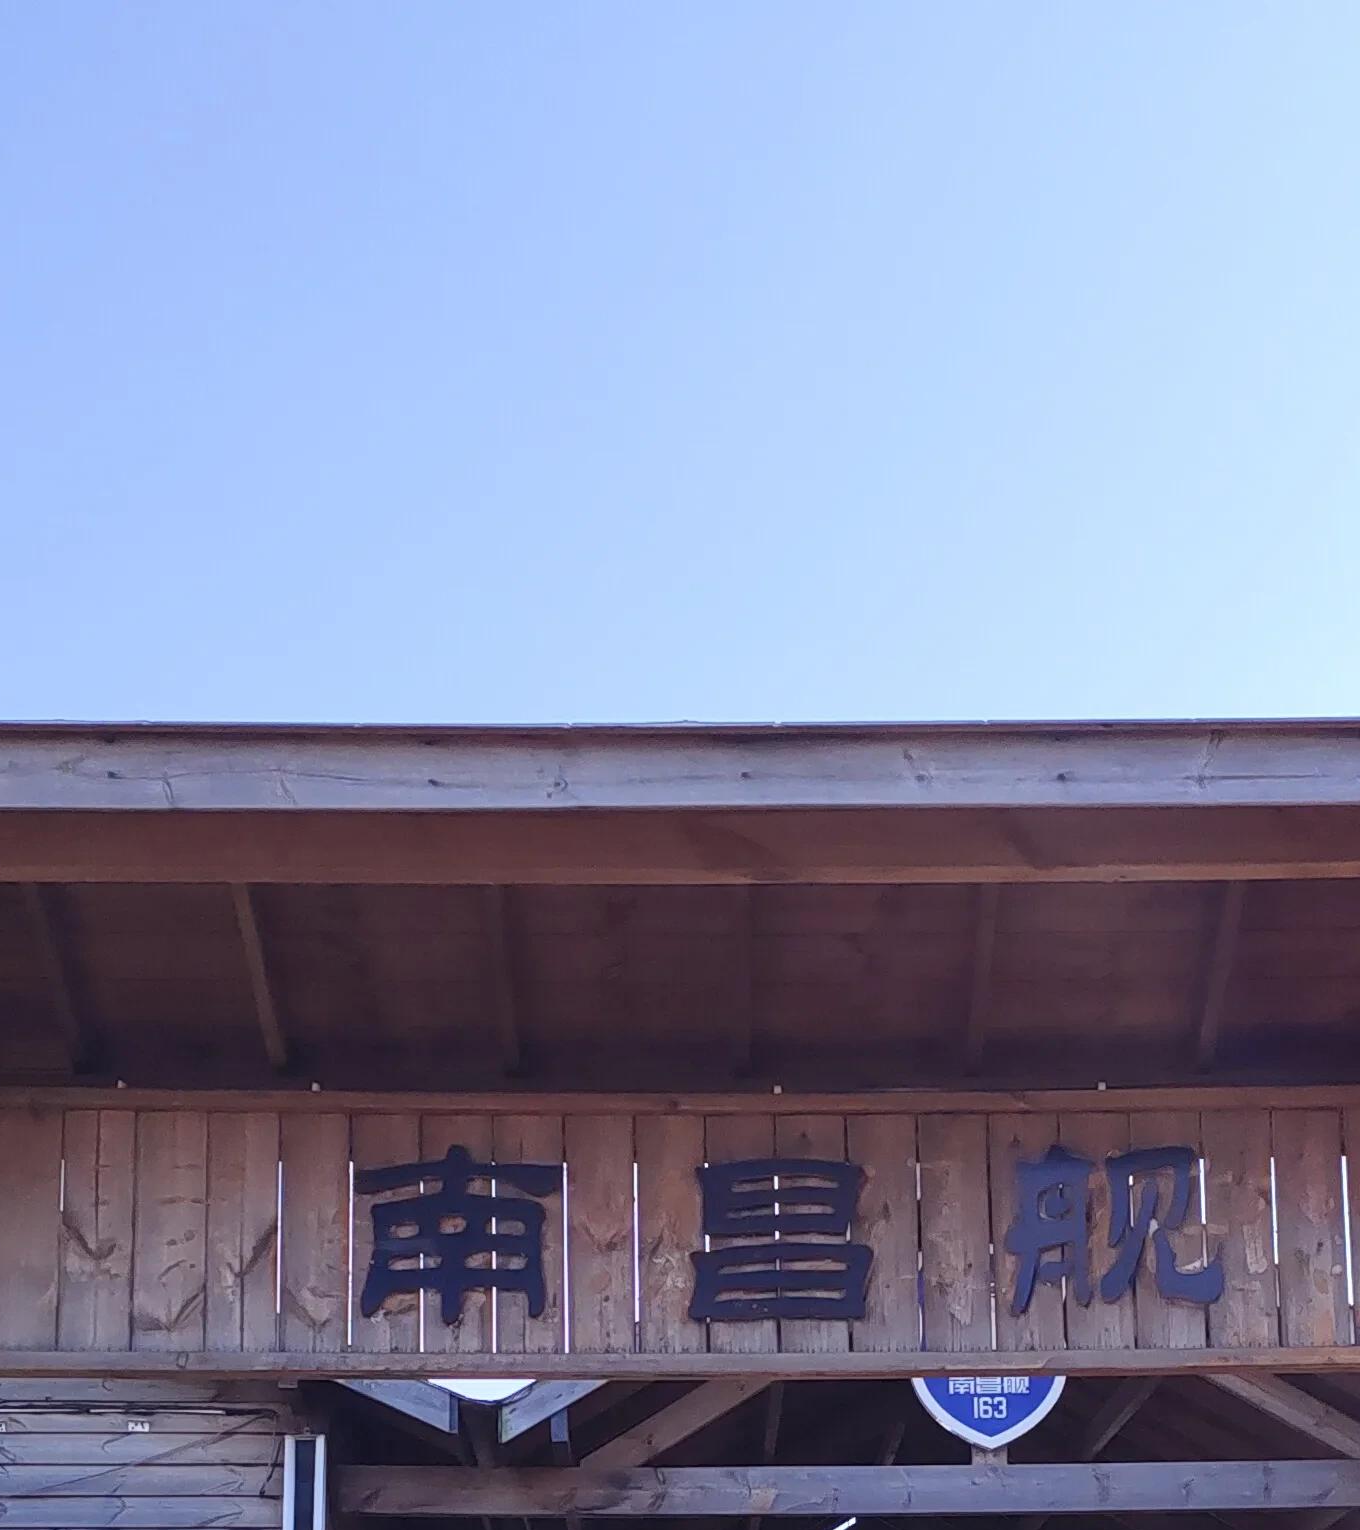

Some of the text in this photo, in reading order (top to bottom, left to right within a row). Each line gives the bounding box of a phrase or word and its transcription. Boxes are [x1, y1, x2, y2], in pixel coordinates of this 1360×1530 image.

[352, 1143, 1224, 1325] 南昌舰
[948, 1376, 1030, 1395] 南昌舰
[973, 1396, 1007, 1419] 163
